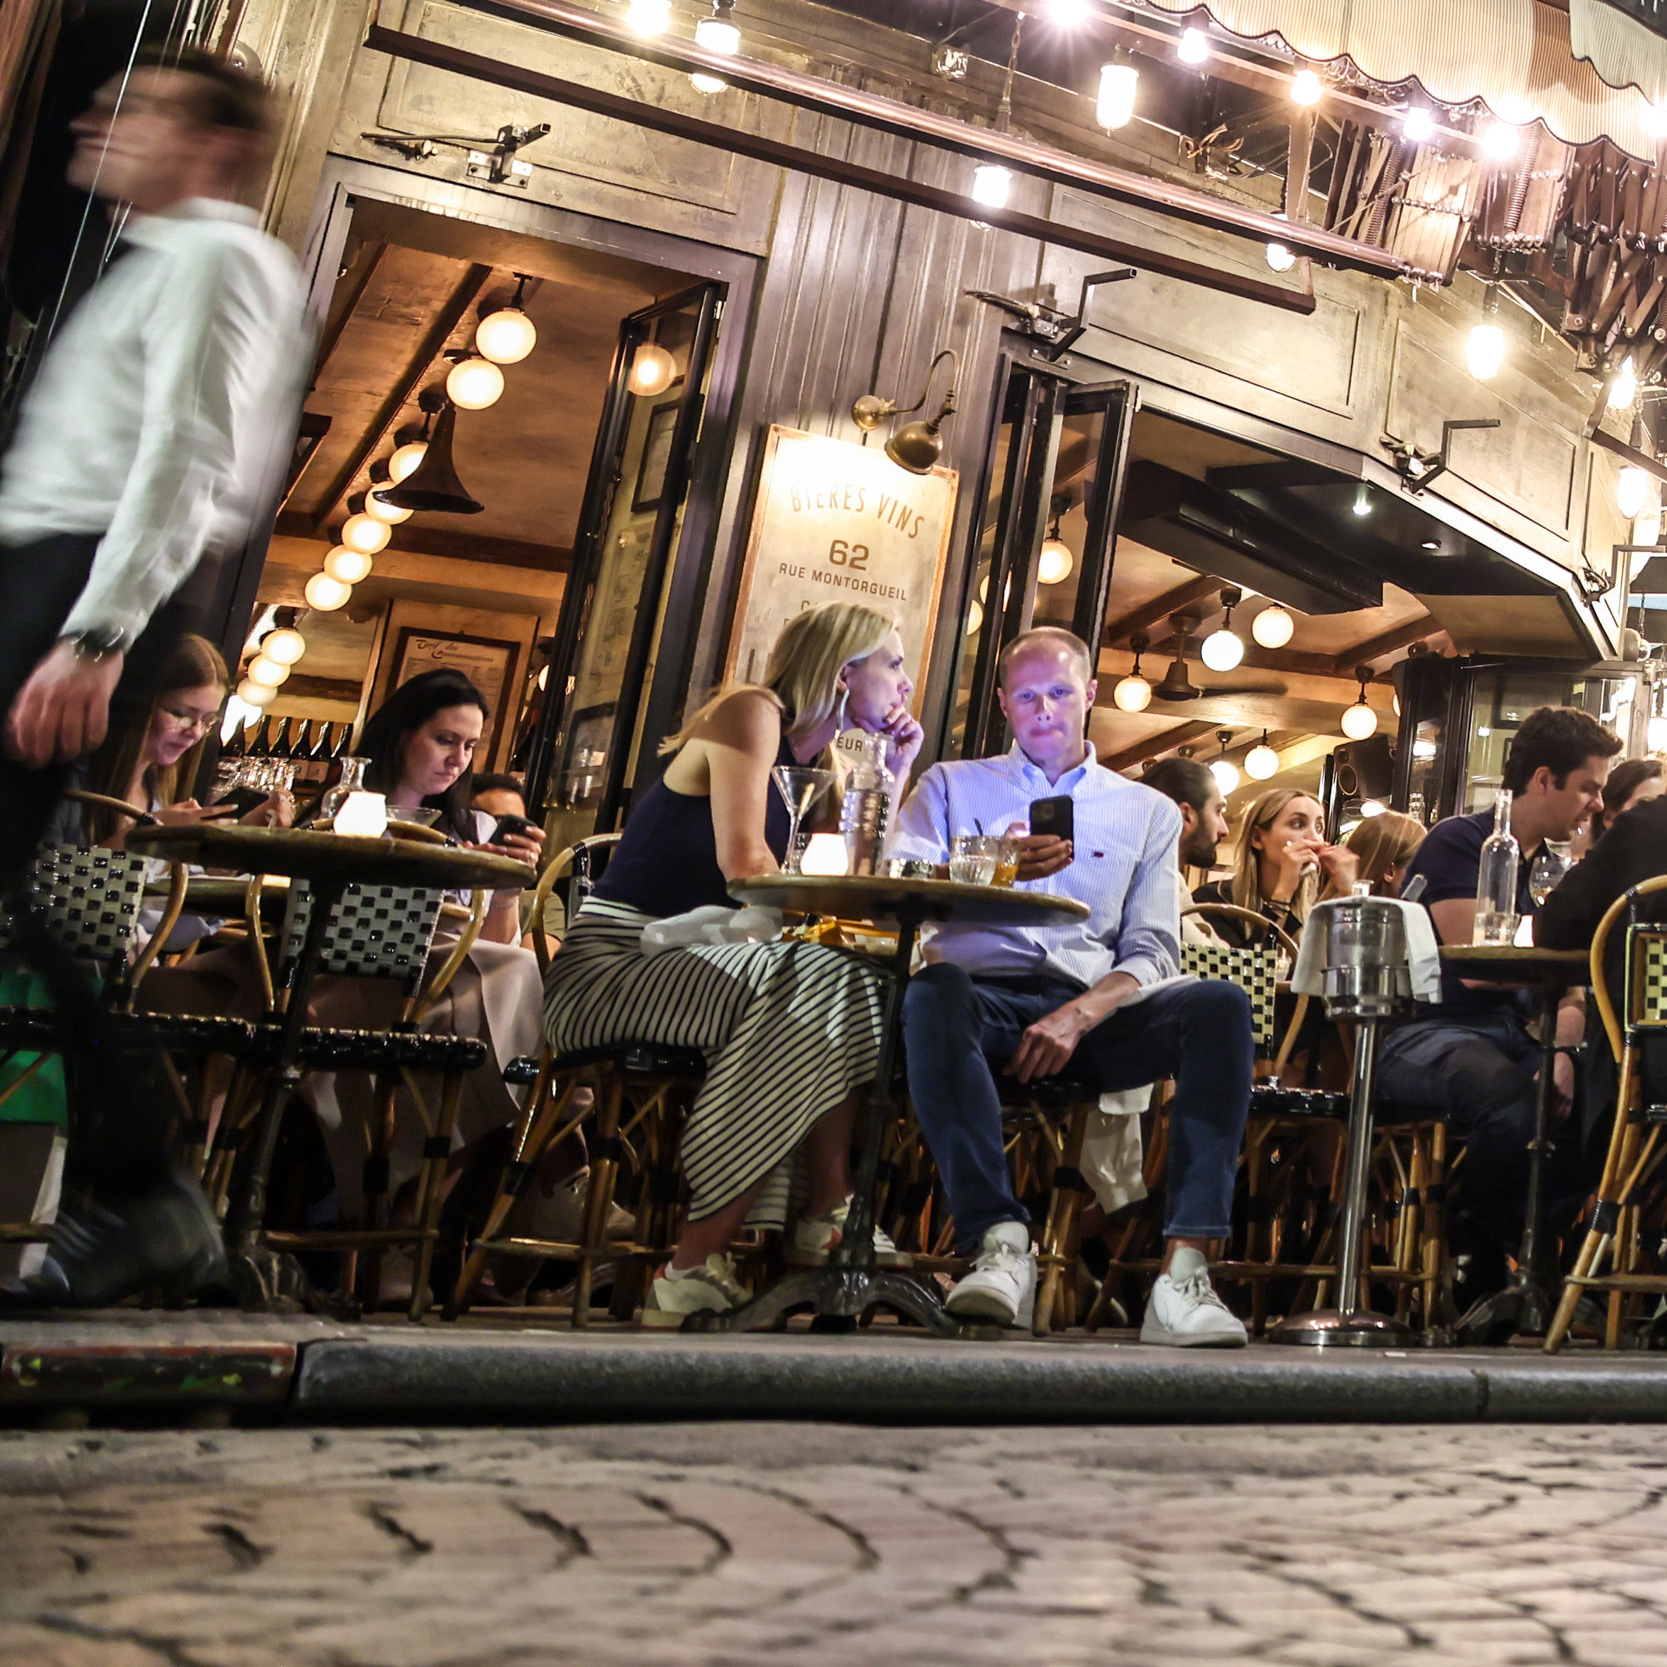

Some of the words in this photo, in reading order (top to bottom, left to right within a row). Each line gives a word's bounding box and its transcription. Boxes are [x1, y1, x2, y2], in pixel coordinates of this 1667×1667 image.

[877, 493, 925, 539] VINS
[829, 539, 869, 571] 62
[778, 562, 806, 579] RUE
[811, 570, 907, 601] MONTORGUEIL
